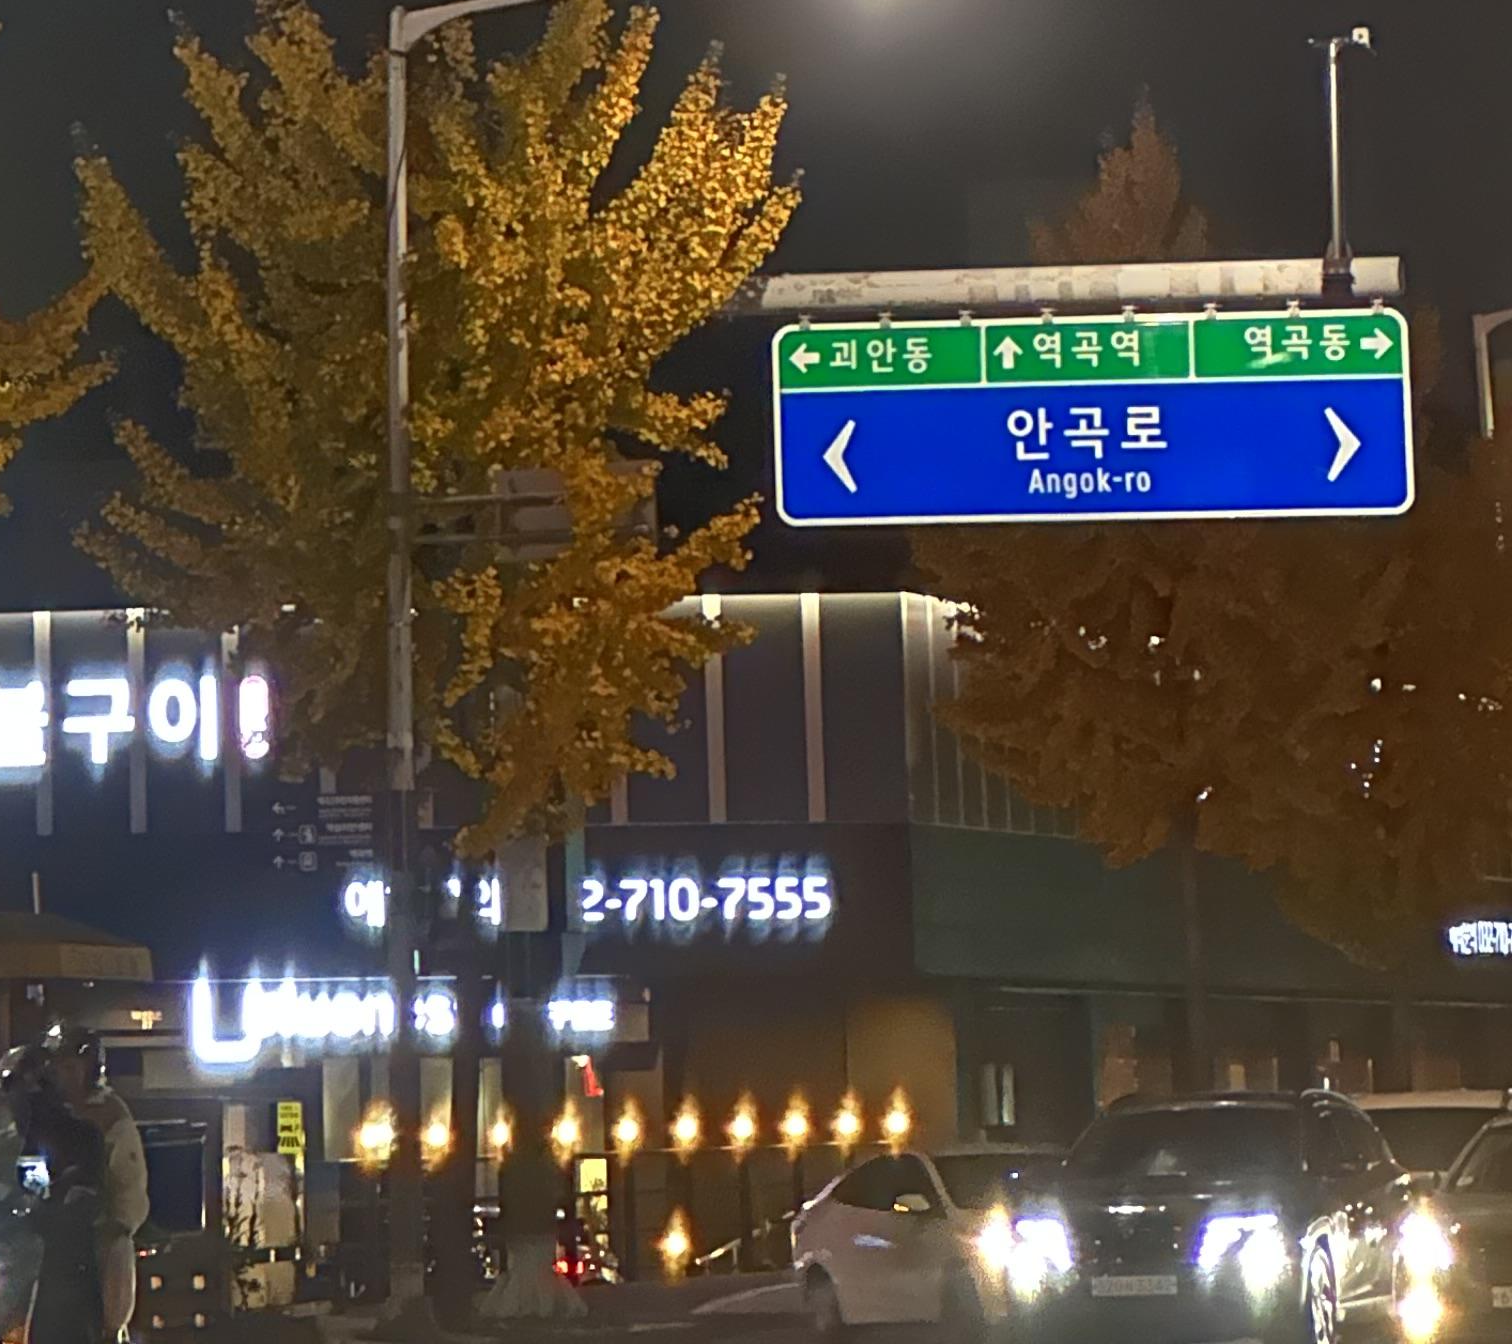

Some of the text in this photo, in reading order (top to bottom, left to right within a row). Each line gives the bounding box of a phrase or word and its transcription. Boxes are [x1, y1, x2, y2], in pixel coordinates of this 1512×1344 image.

[829, 324, 1351, 374] 괴안동 역곡역 역곡동
[1006, 405, 1168, 461] 안곡로
[1028, 467, 1152, 500] Angok-ro
